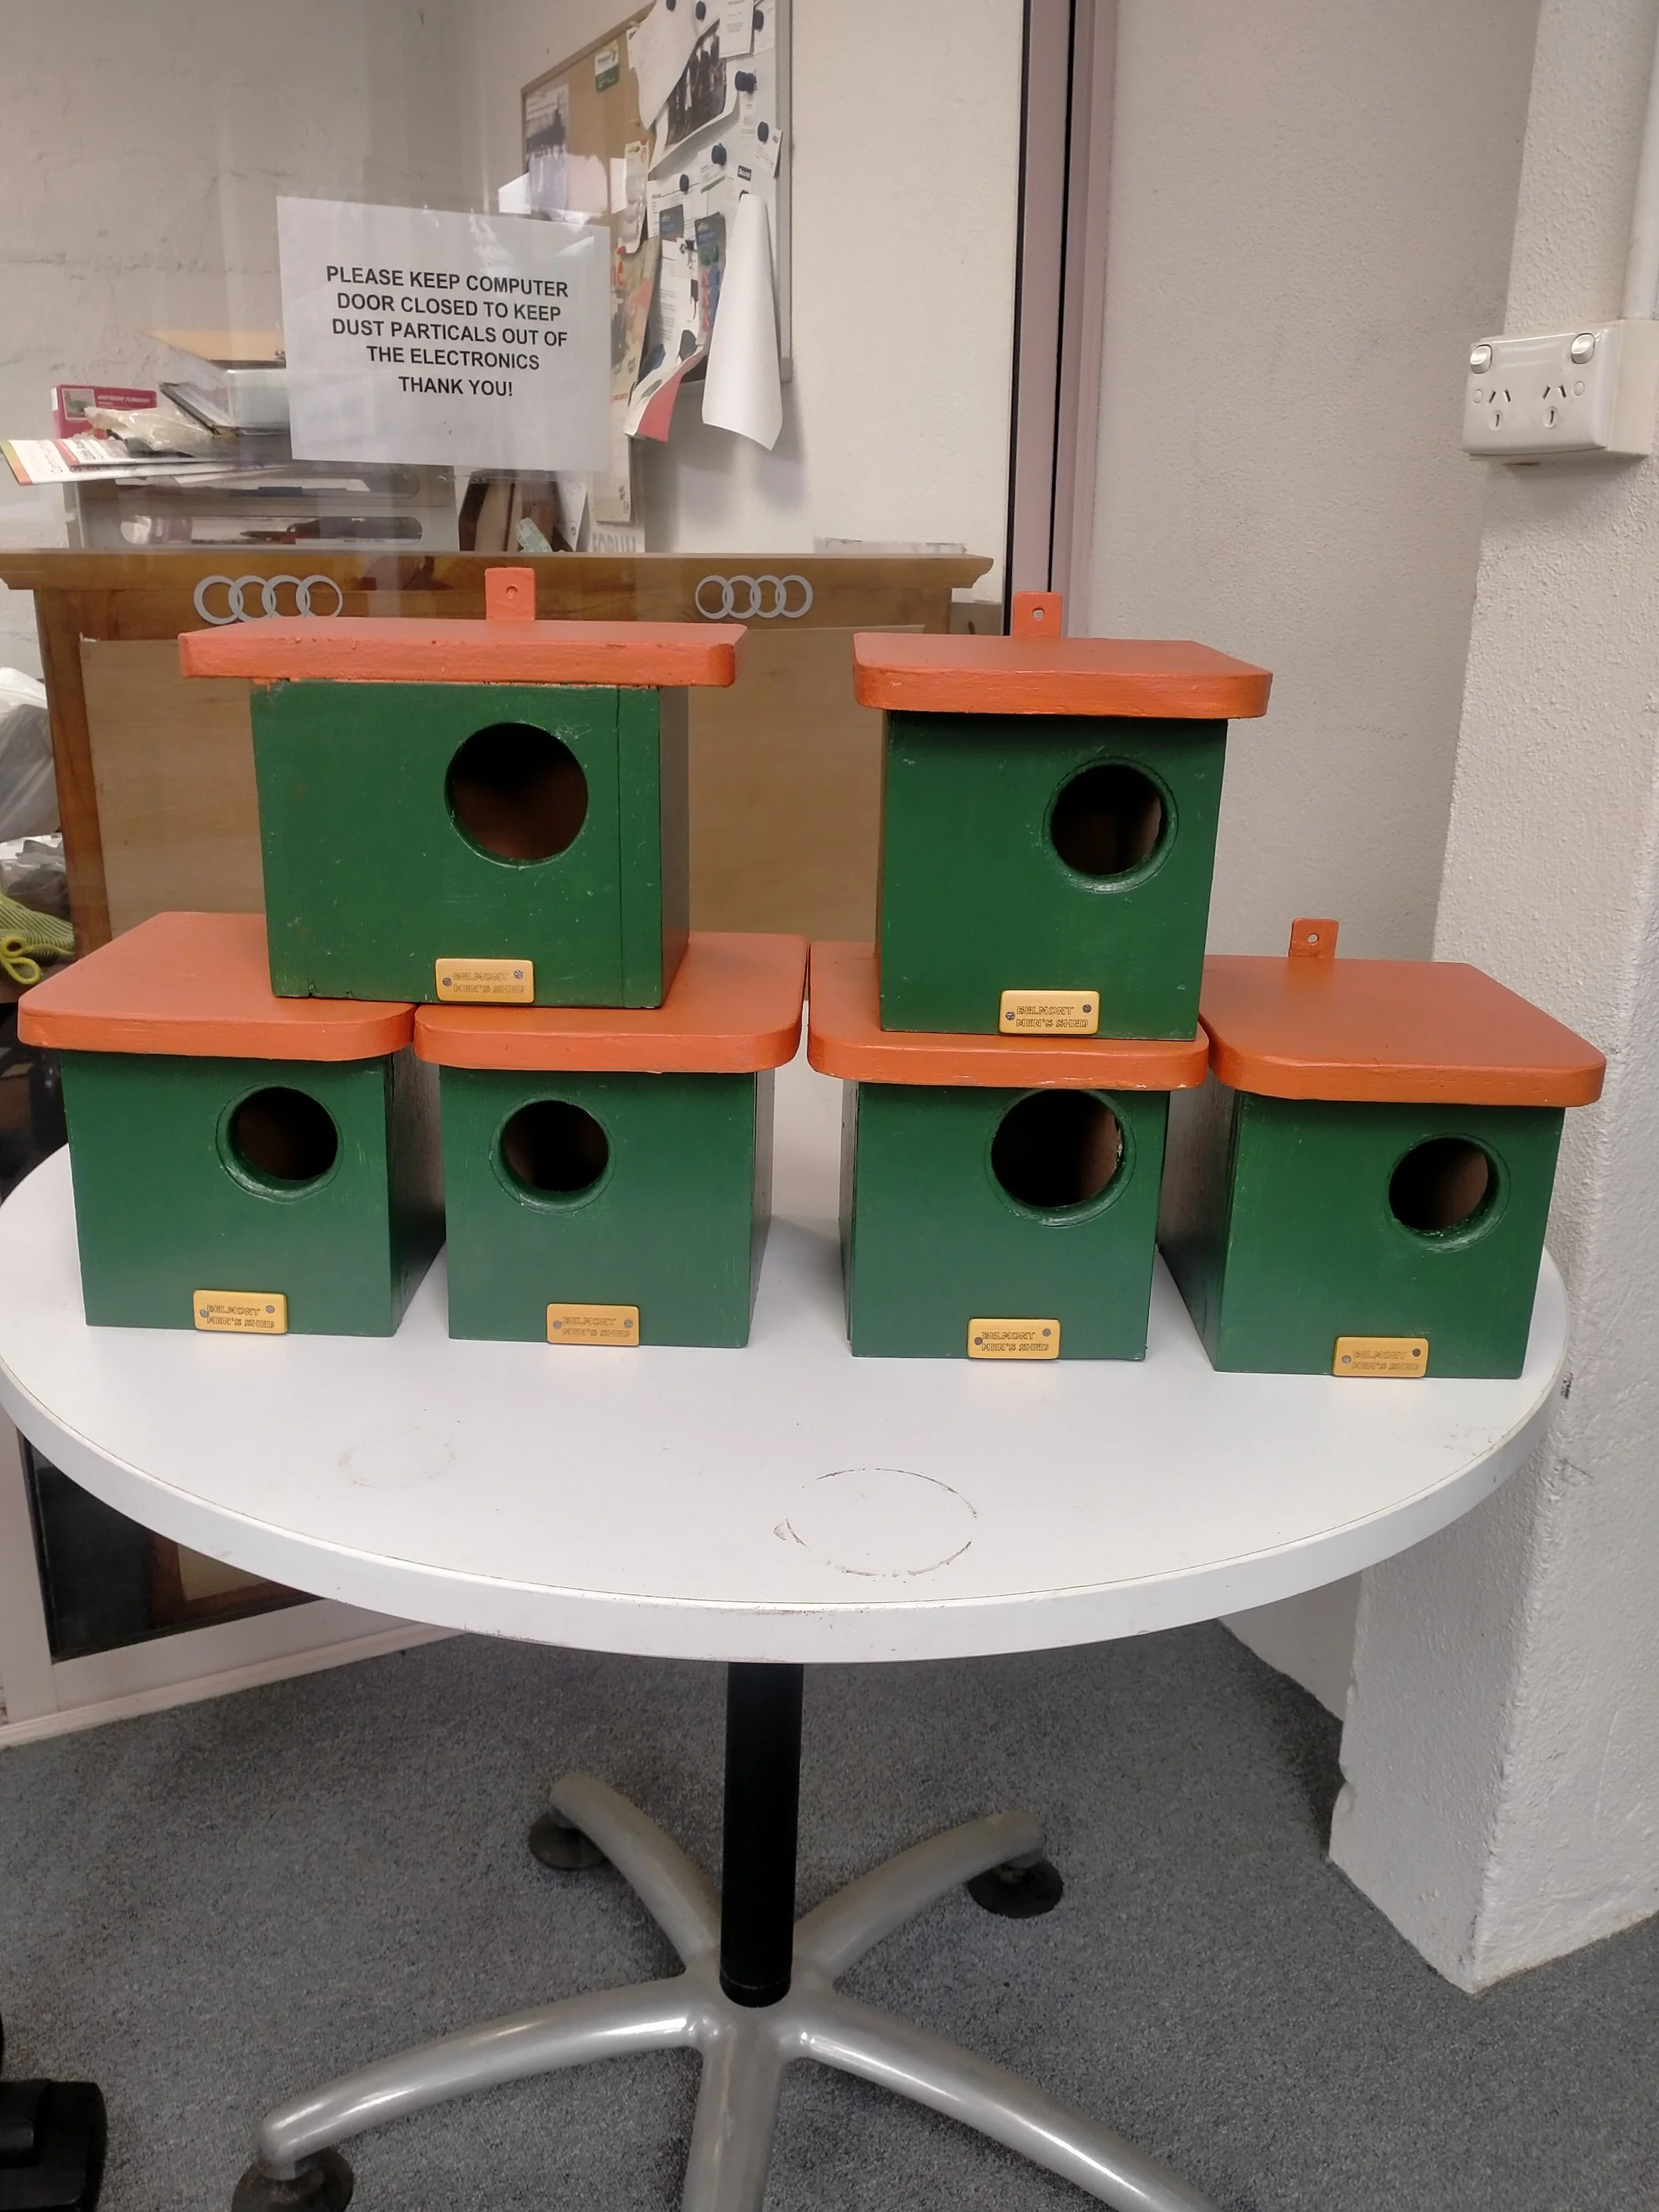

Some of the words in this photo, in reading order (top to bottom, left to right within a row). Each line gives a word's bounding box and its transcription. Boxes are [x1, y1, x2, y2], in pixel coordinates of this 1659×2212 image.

[326, 265, 404, 286] PLEASE
[410, 271, 460, 289] KEEP
[466, 275, 569, 298] COMPUTER
[337, 292, 395, 312] DOOR
[401, 296, 478, 316] CLOSED
[483, 301, 508, 319] TO
[514, 303, 561, 322] KEEP
[332, 318, 384, 336] DUST
[391, 321, 496, 342] PARTICALS
[502, 328, 539, 345] OUT
[543, 331, 568, 347] OF
[366, 346, 405, 363] THE
[410, 348, 540, 370] ELECTRONICS
[398, 376, 464, 395] THANK
[469, 379, 512, 397] YOU!
[1017, 1005, 1074, 1015] BELMONT
[1016, 1018, 1053, 1027] MEN'S
[1056, 1019, 1088, 1028] SHED
[207, 1304, 261, 1316] BELMONT
[207, 1316, 242, 1326] MEN'S
[244, 1319, 275, 1329] SHED
[981, 1331, 1036, 1340] BELMONT
[981, 1343, 1016, 1351] MEN'S
